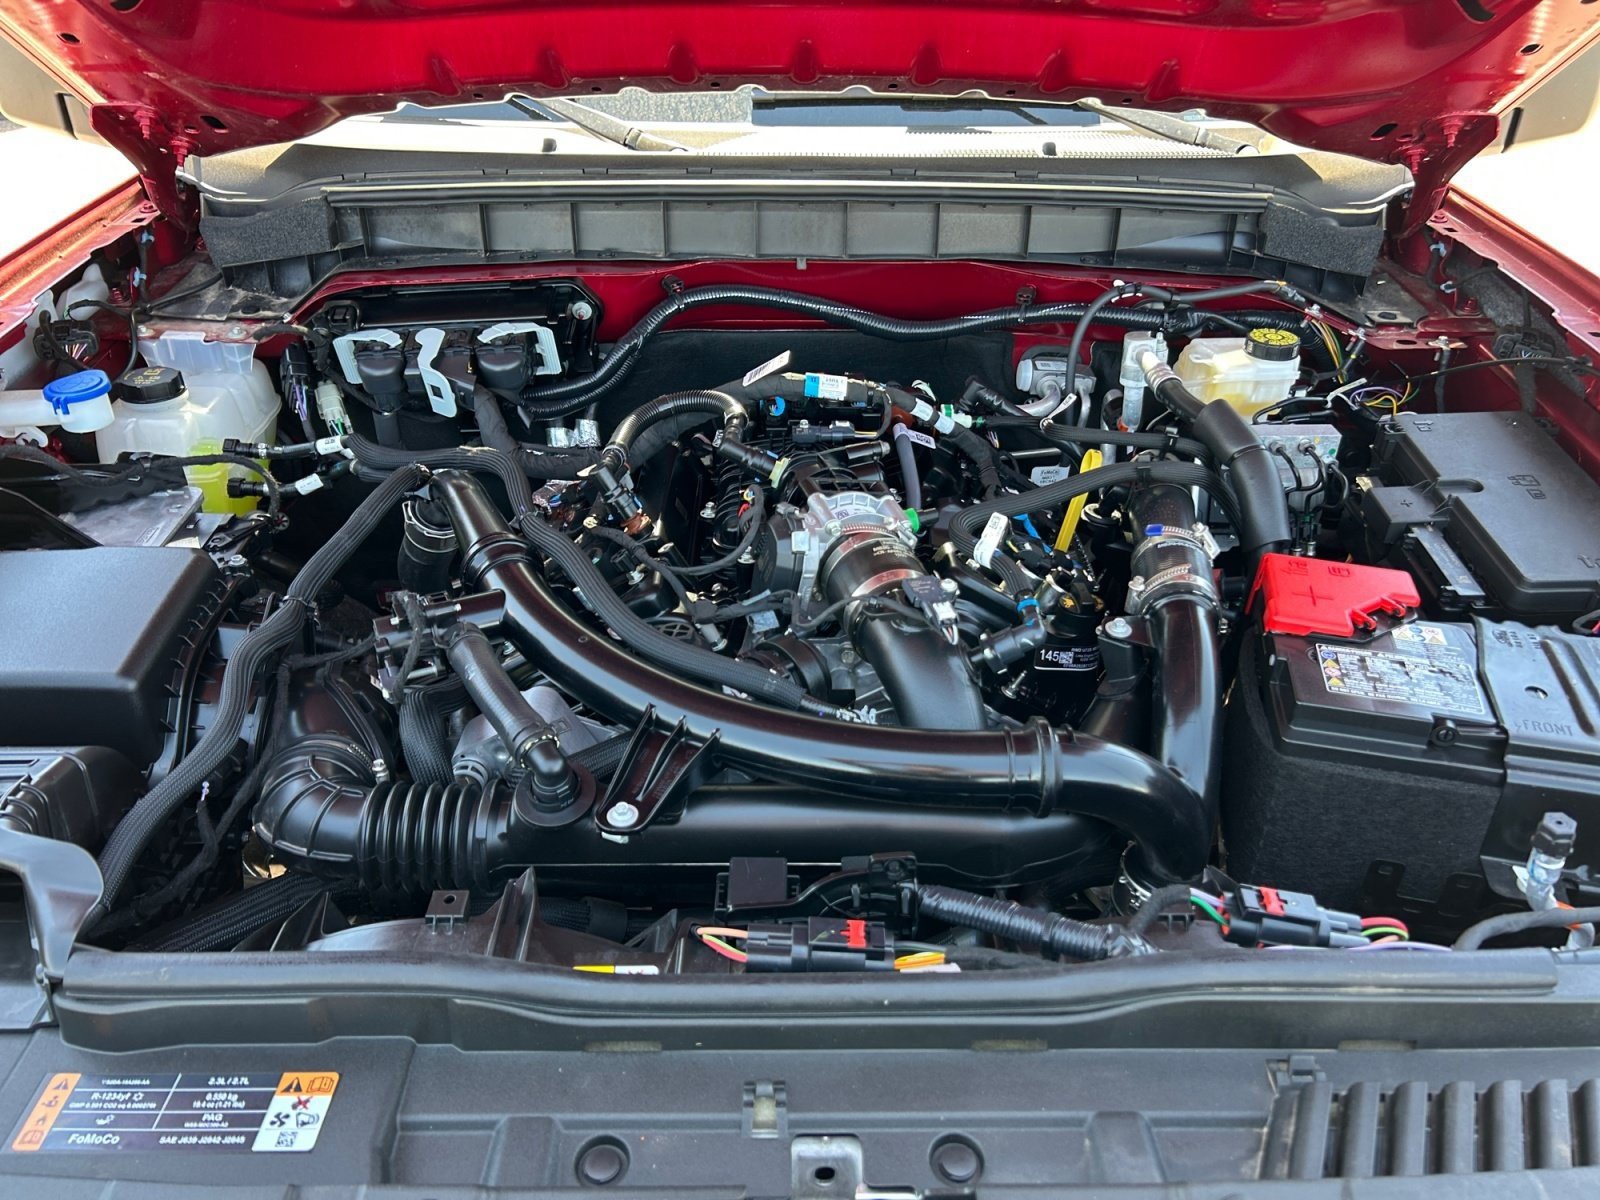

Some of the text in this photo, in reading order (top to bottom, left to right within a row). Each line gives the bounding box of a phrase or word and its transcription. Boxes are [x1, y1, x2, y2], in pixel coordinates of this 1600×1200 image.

[1039, 649, 1060, 662] 145
[1521, 719, 1574, 737] FRONT
[208, 1076, 226, 1086] 2.3L
[232, 1076, 250, 1086] 2.7L
[90, 1092, 132, 1102] R-1234yf
[227, 1092, 239, 1103] kg
[202, 1113, 223, 1122] PAG
[67, 1133, 121, 1145] FoMoCo
[159, 1135, 178, 1144] SAE
[178, 1135, 198, 1144] J639
